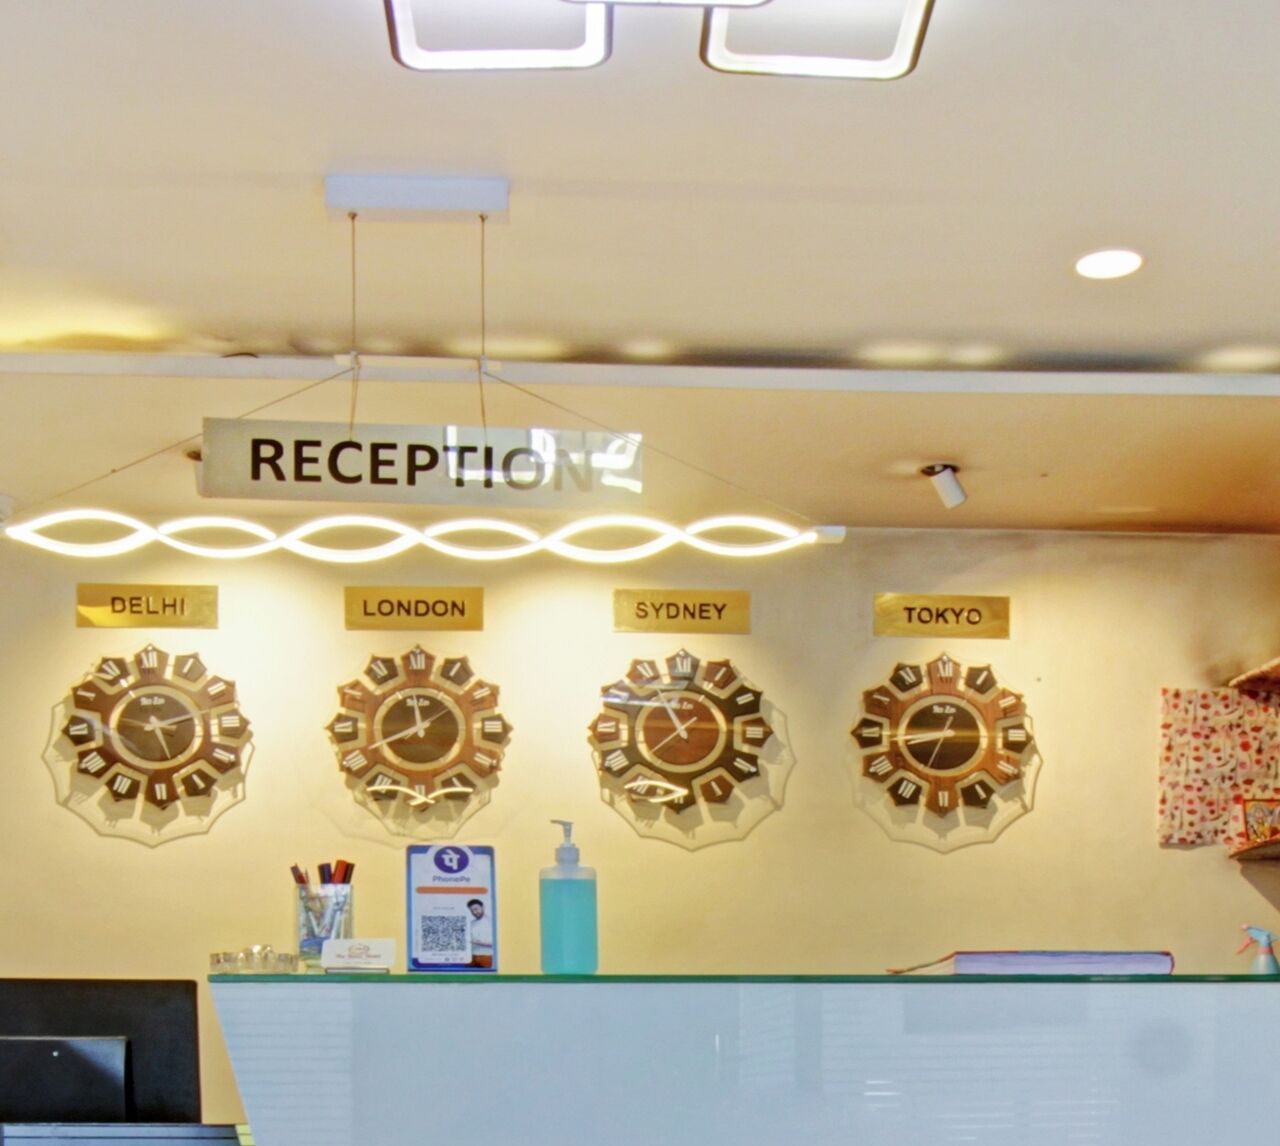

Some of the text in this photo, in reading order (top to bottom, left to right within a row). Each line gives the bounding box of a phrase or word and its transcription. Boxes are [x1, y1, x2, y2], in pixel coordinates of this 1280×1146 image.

[249, 437, 593, 493] RECEPTION
[110, 596, 186, 615] DELHI
[362, 599, 466, 618] LONDON
[634, 602, 728, 620] SYDNEY
[903, 606, 983, 625] TOKYO
[432, 875, 471, 883] PhonePe
